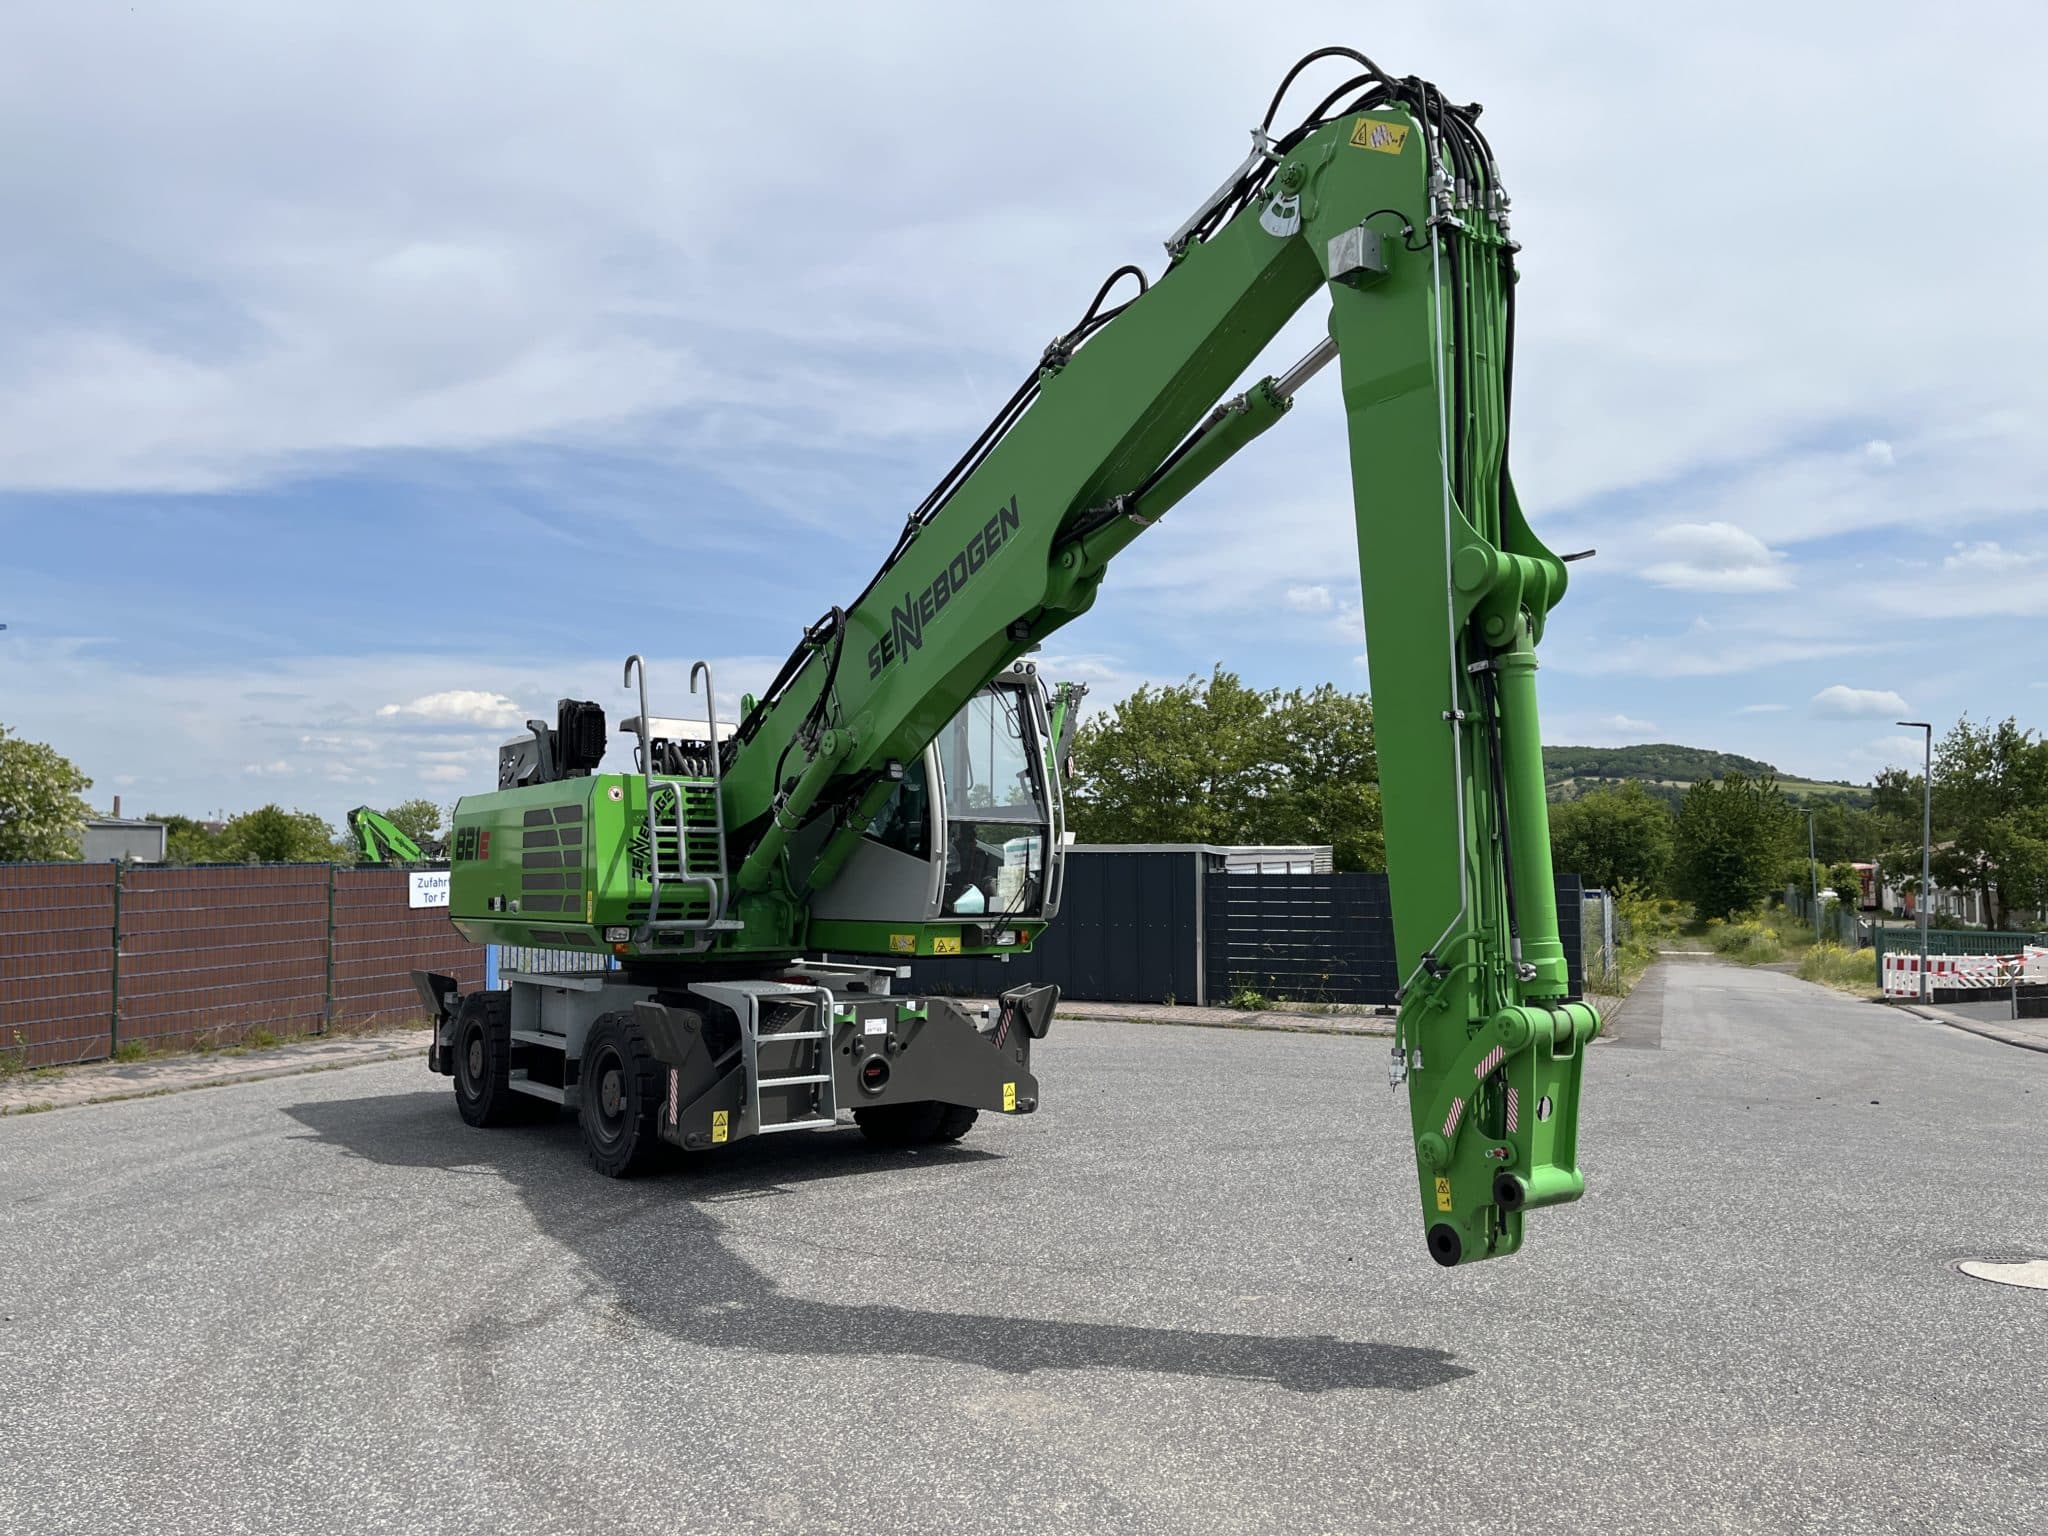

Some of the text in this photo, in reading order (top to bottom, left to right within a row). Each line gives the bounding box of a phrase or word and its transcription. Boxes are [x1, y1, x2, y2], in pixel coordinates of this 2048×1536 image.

[867, 494, 1020, 681] SENNEBOGEN
[417, 877, 450, 888] Zufahr
[424, 892, 447, 903] Tor F
